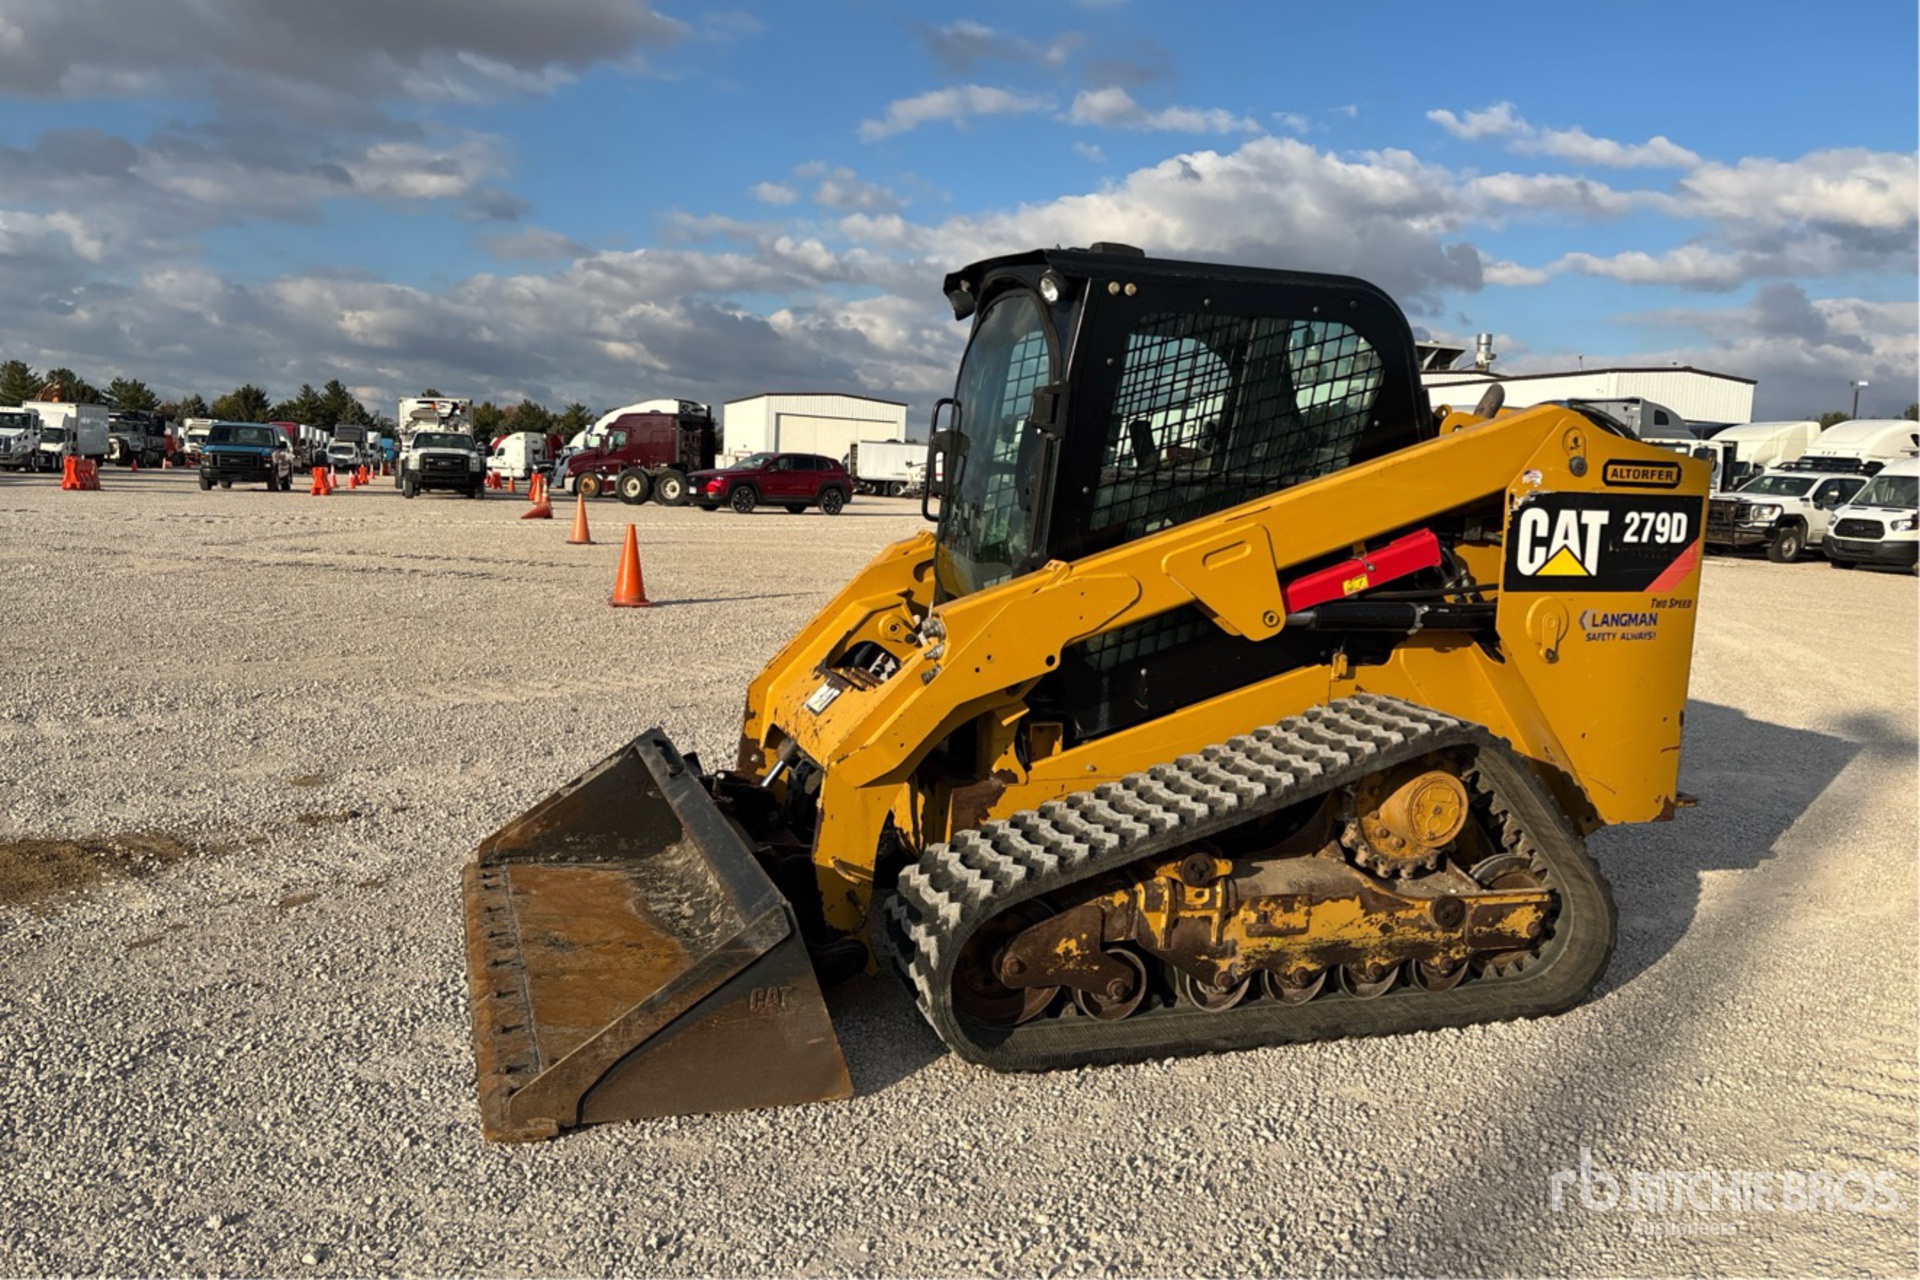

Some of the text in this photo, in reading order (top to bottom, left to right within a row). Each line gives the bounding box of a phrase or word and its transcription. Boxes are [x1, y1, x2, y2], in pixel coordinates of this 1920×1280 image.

[1610, 467, 1674, 481] ALTORFER
[1517, 507, 1688, 577] CAT 279D
[1591, 612, 1658, 628] LANGMAN
[1585, 631, 1657, 642] SAFETY ALWAYS!
[749, 985, 793, 1012] CAT
